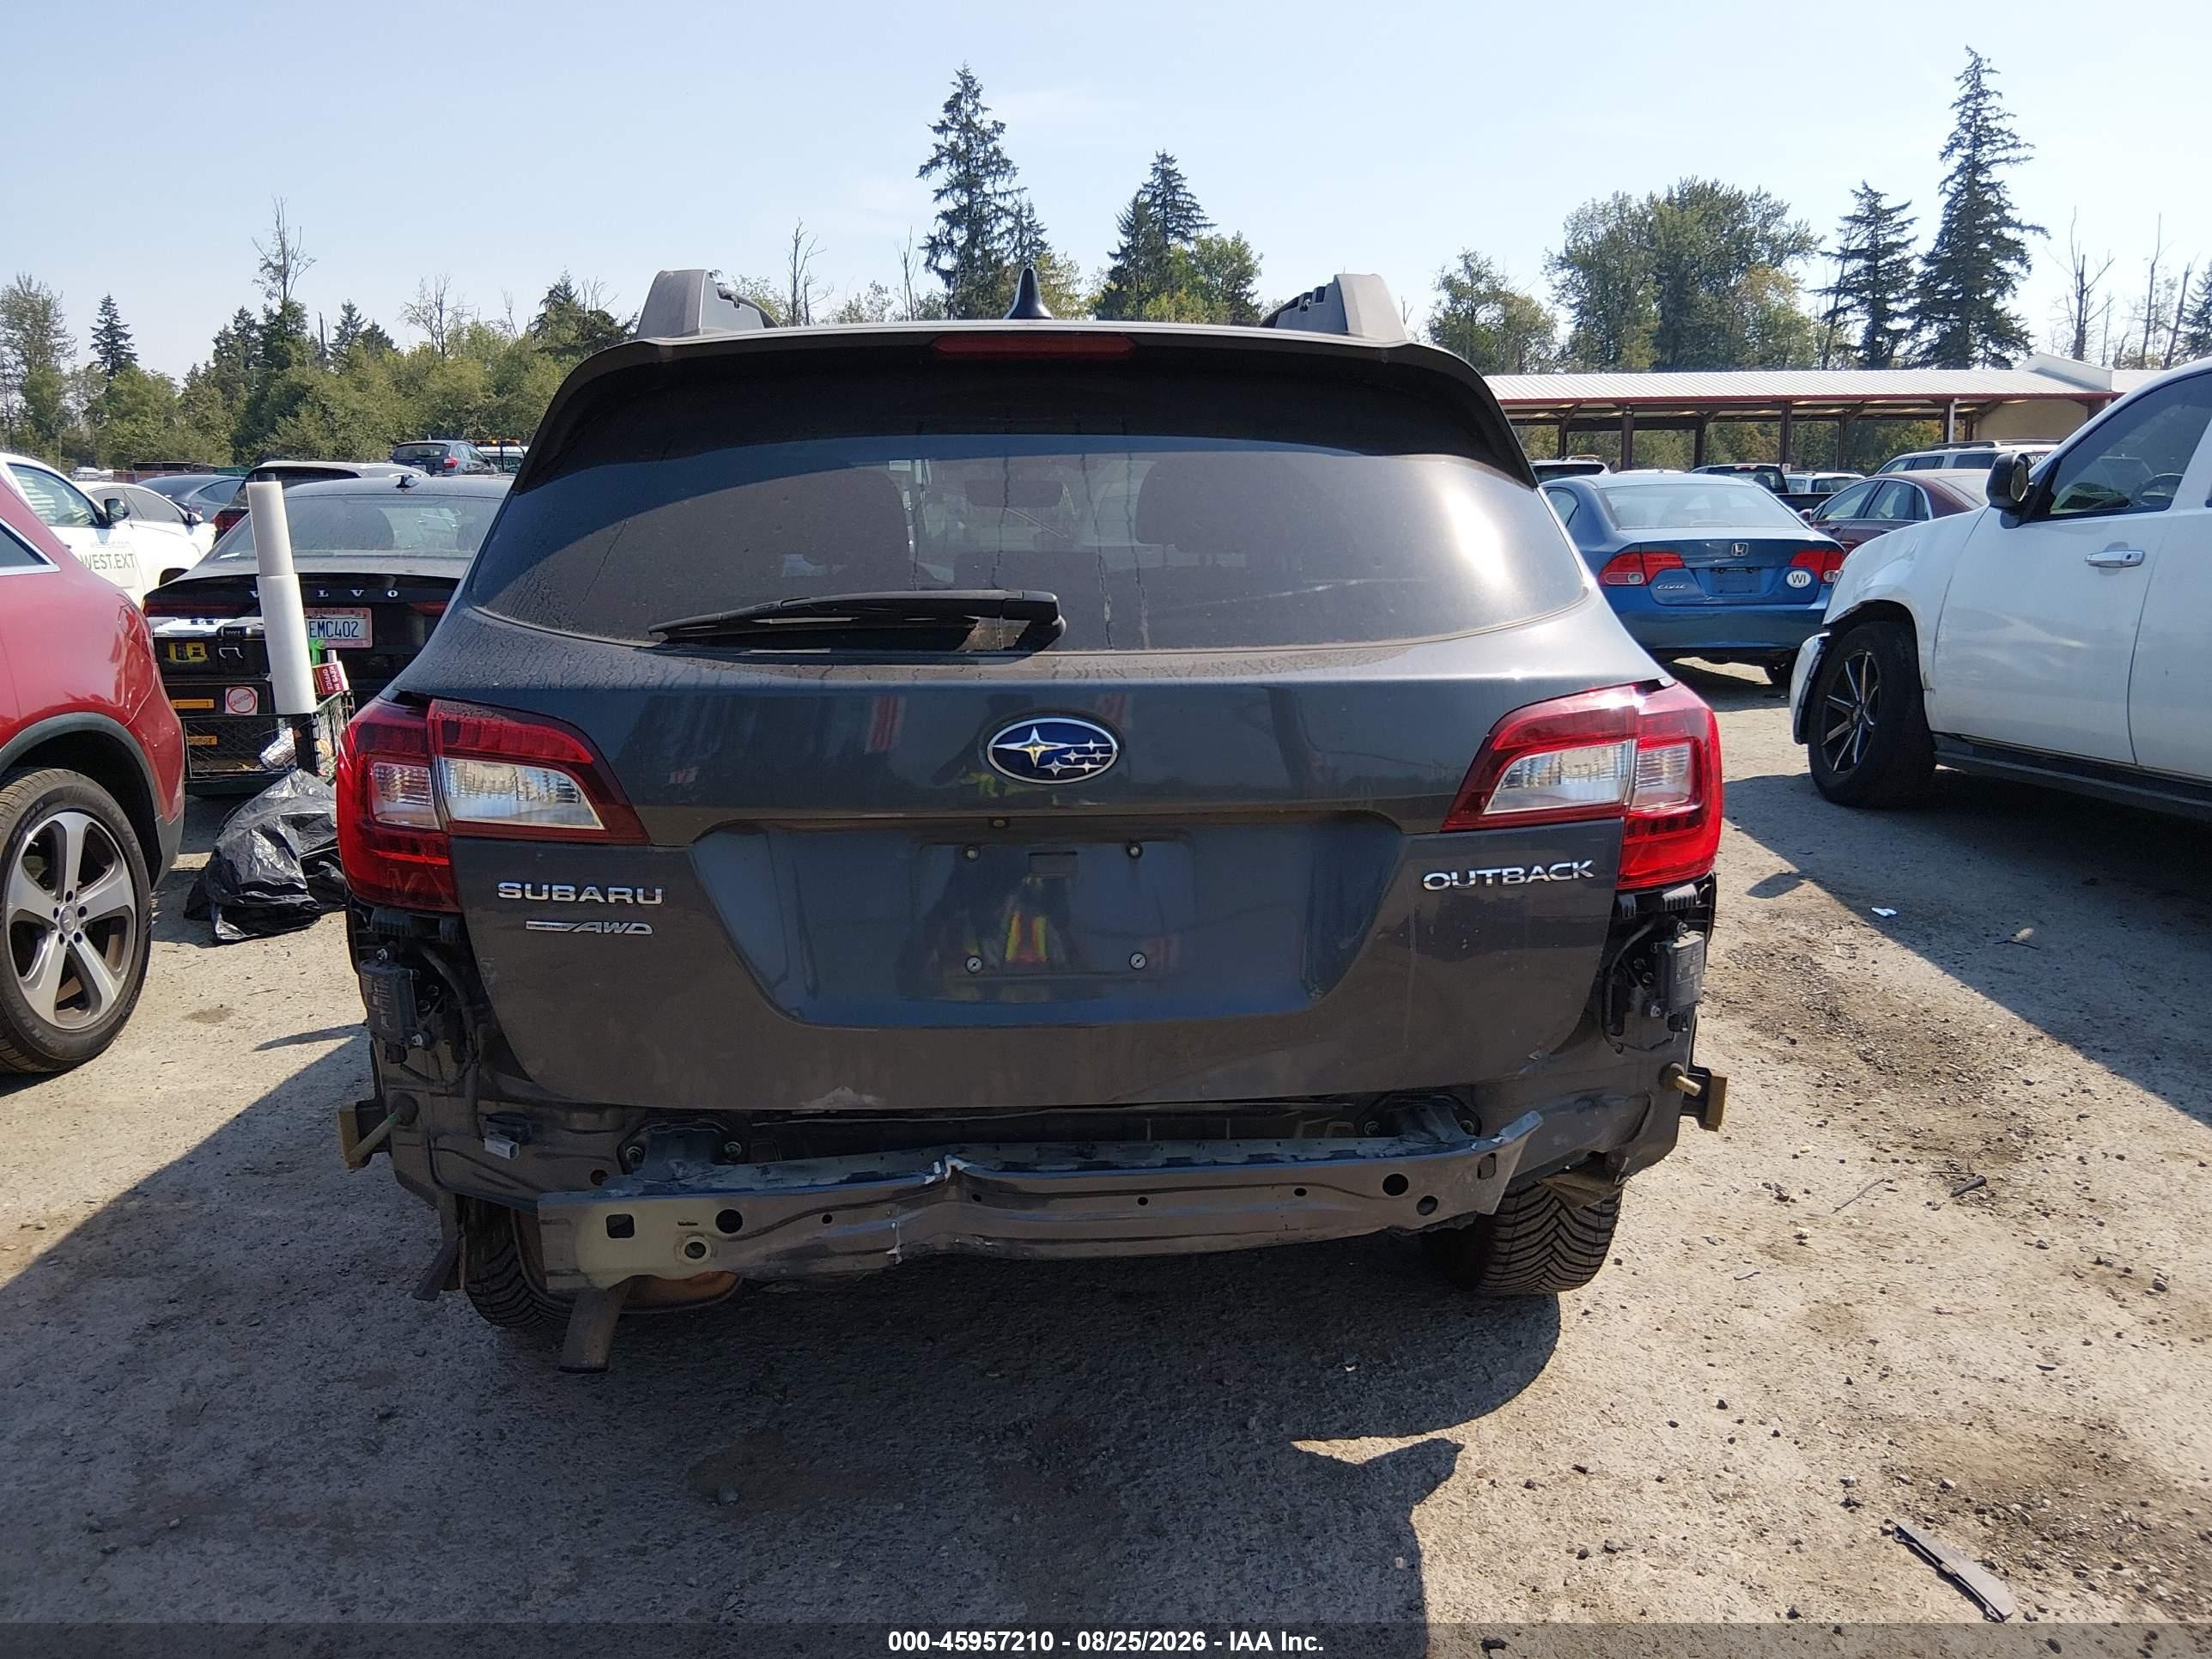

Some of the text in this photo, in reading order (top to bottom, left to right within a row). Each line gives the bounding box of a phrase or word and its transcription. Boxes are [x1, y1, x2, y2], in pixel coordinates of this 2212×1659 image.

[1791, 573, 1806, 584] WI
[249, 589, 398, 599] VLVO
[308, 620, 360, 638] EMC402
[1423, 860, 1595, 890] OUTBACK
[497, 882, 663, 905] SUBARU
[573, 921, 653, 935] AWD
